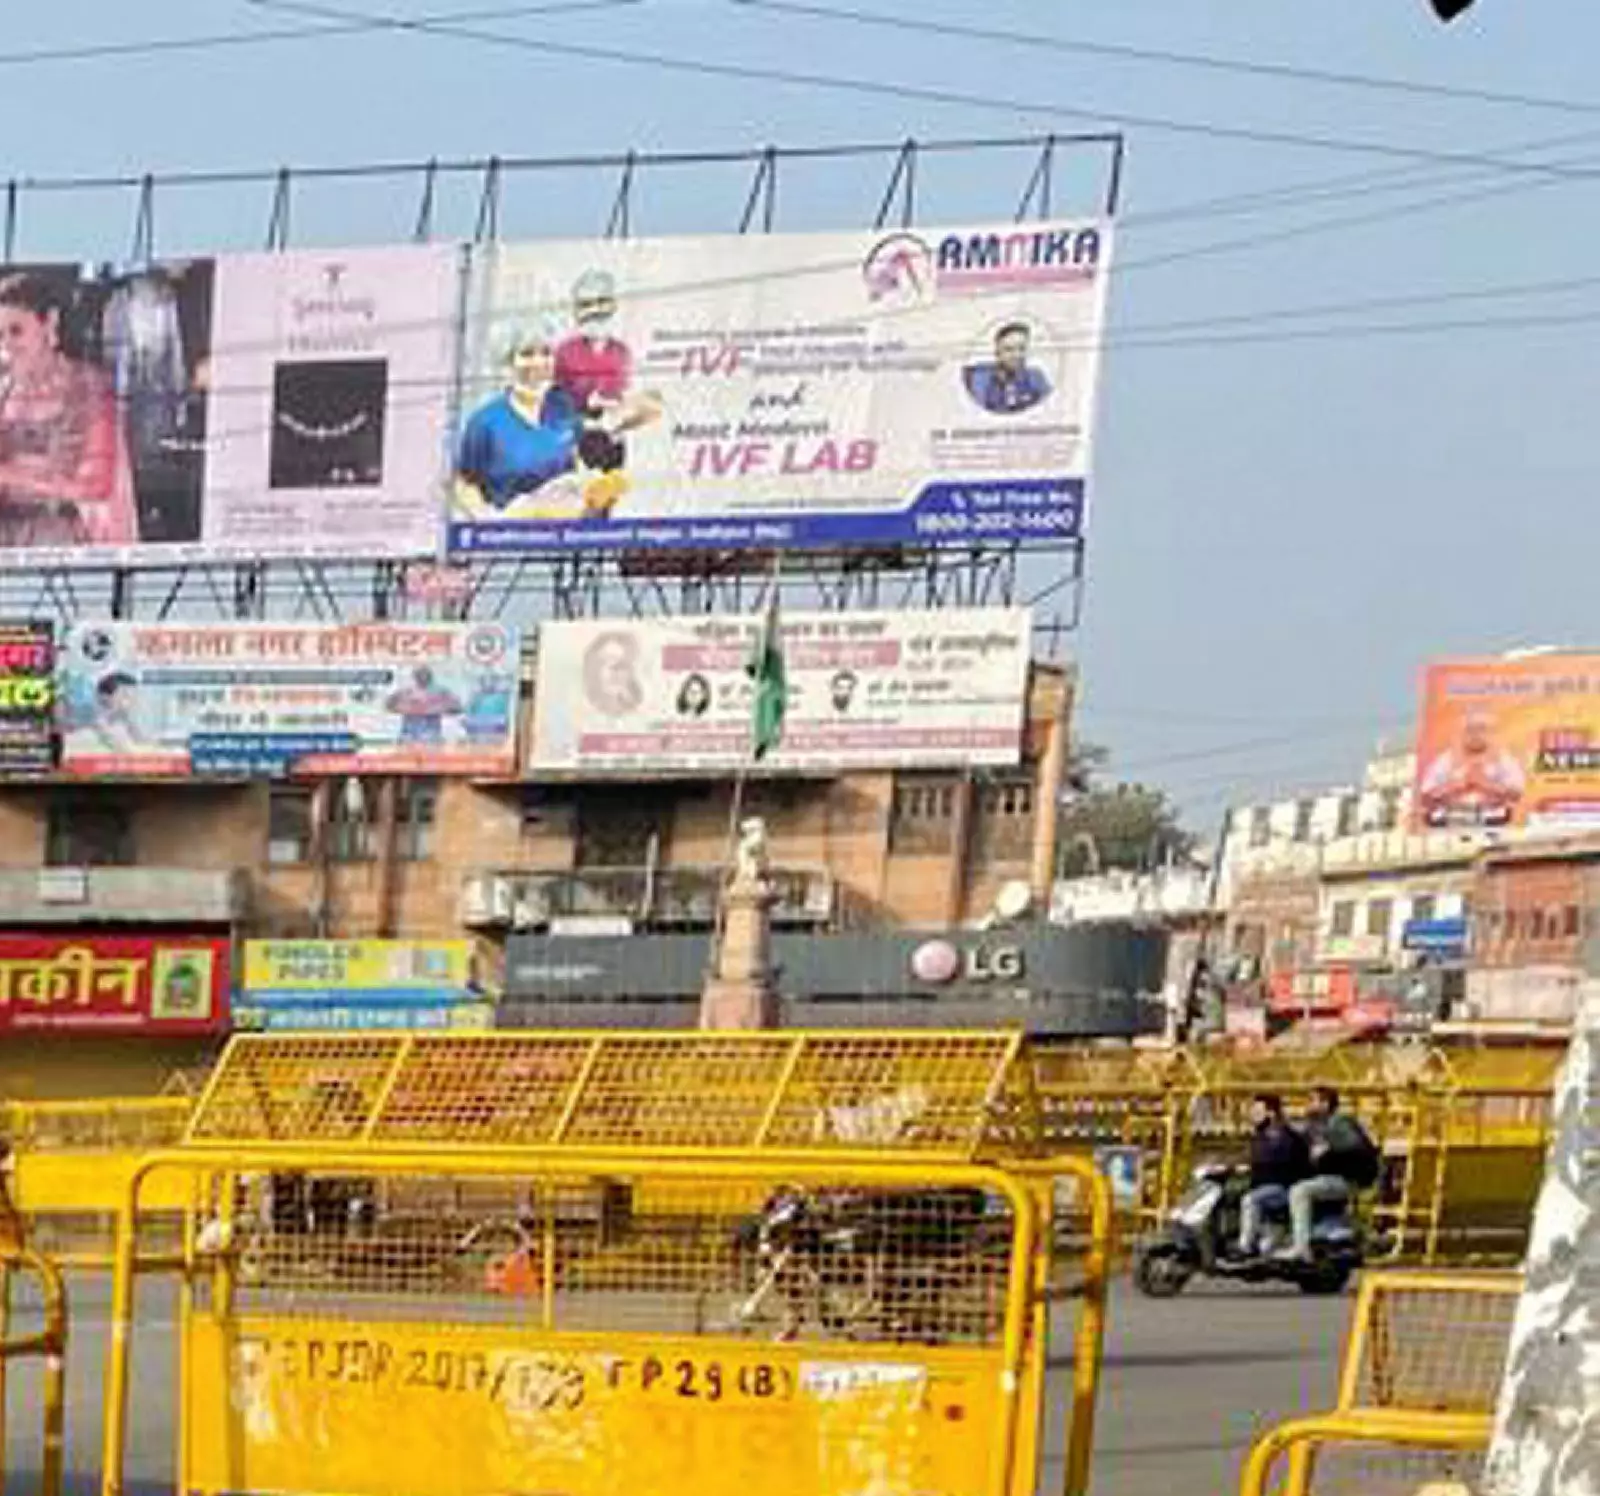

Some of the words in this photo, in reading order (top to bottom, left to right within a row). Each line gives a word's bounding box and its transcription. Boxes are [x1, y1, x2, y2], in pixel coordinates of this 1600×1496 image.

[688, 443, 772, 477] IVF
[779, 438, 879, 476] LAB
[964, 946, 1026, 979] LG
